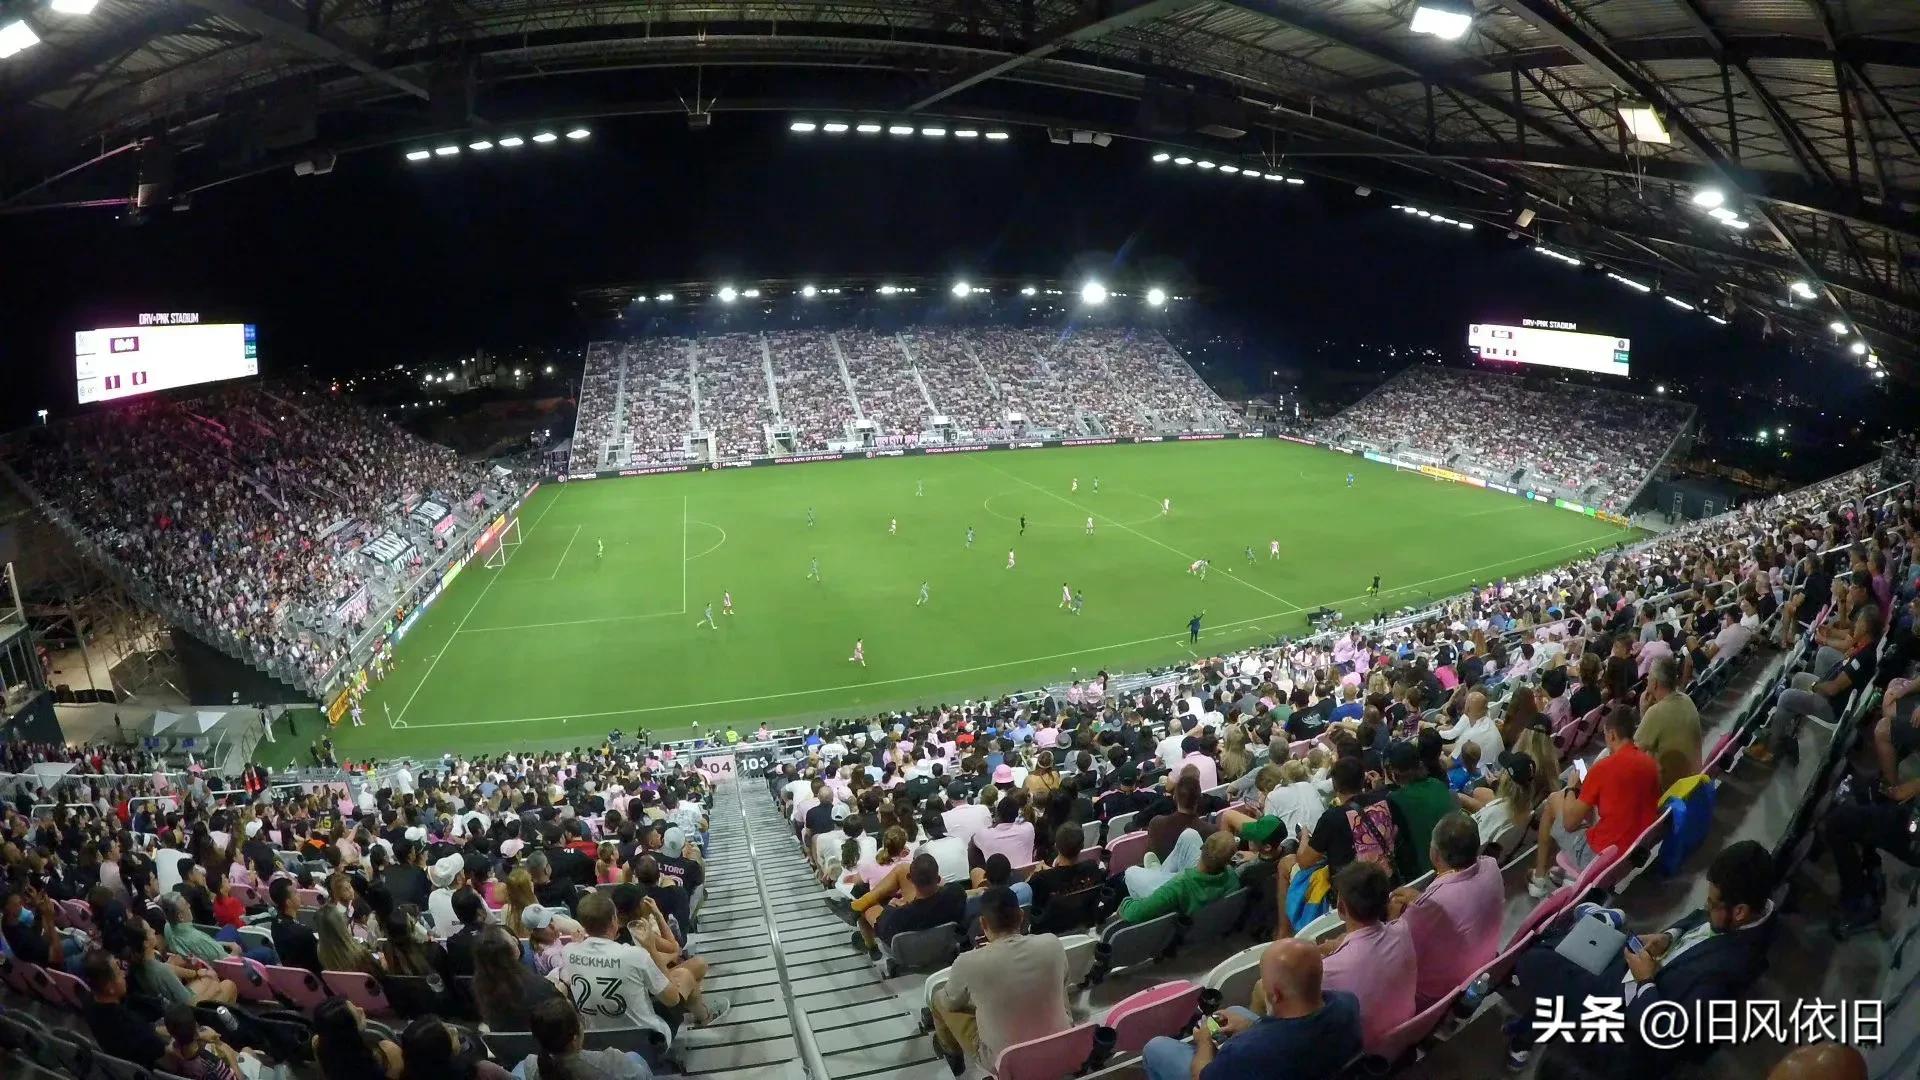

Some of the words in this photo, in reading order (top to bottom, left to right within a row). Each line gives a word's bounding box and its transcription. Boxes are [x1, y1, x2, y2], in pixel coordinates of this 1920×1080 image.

[170, 312, 199, 324] STADIUM
[1549, 320, 1577, 330] STADIUM
[741, 756, 769, 771] 103
[663, 864, 685, 875] TORO
[569, 953, 621, 969] BECKHAM
[570, 973, 628, 1018] 23
